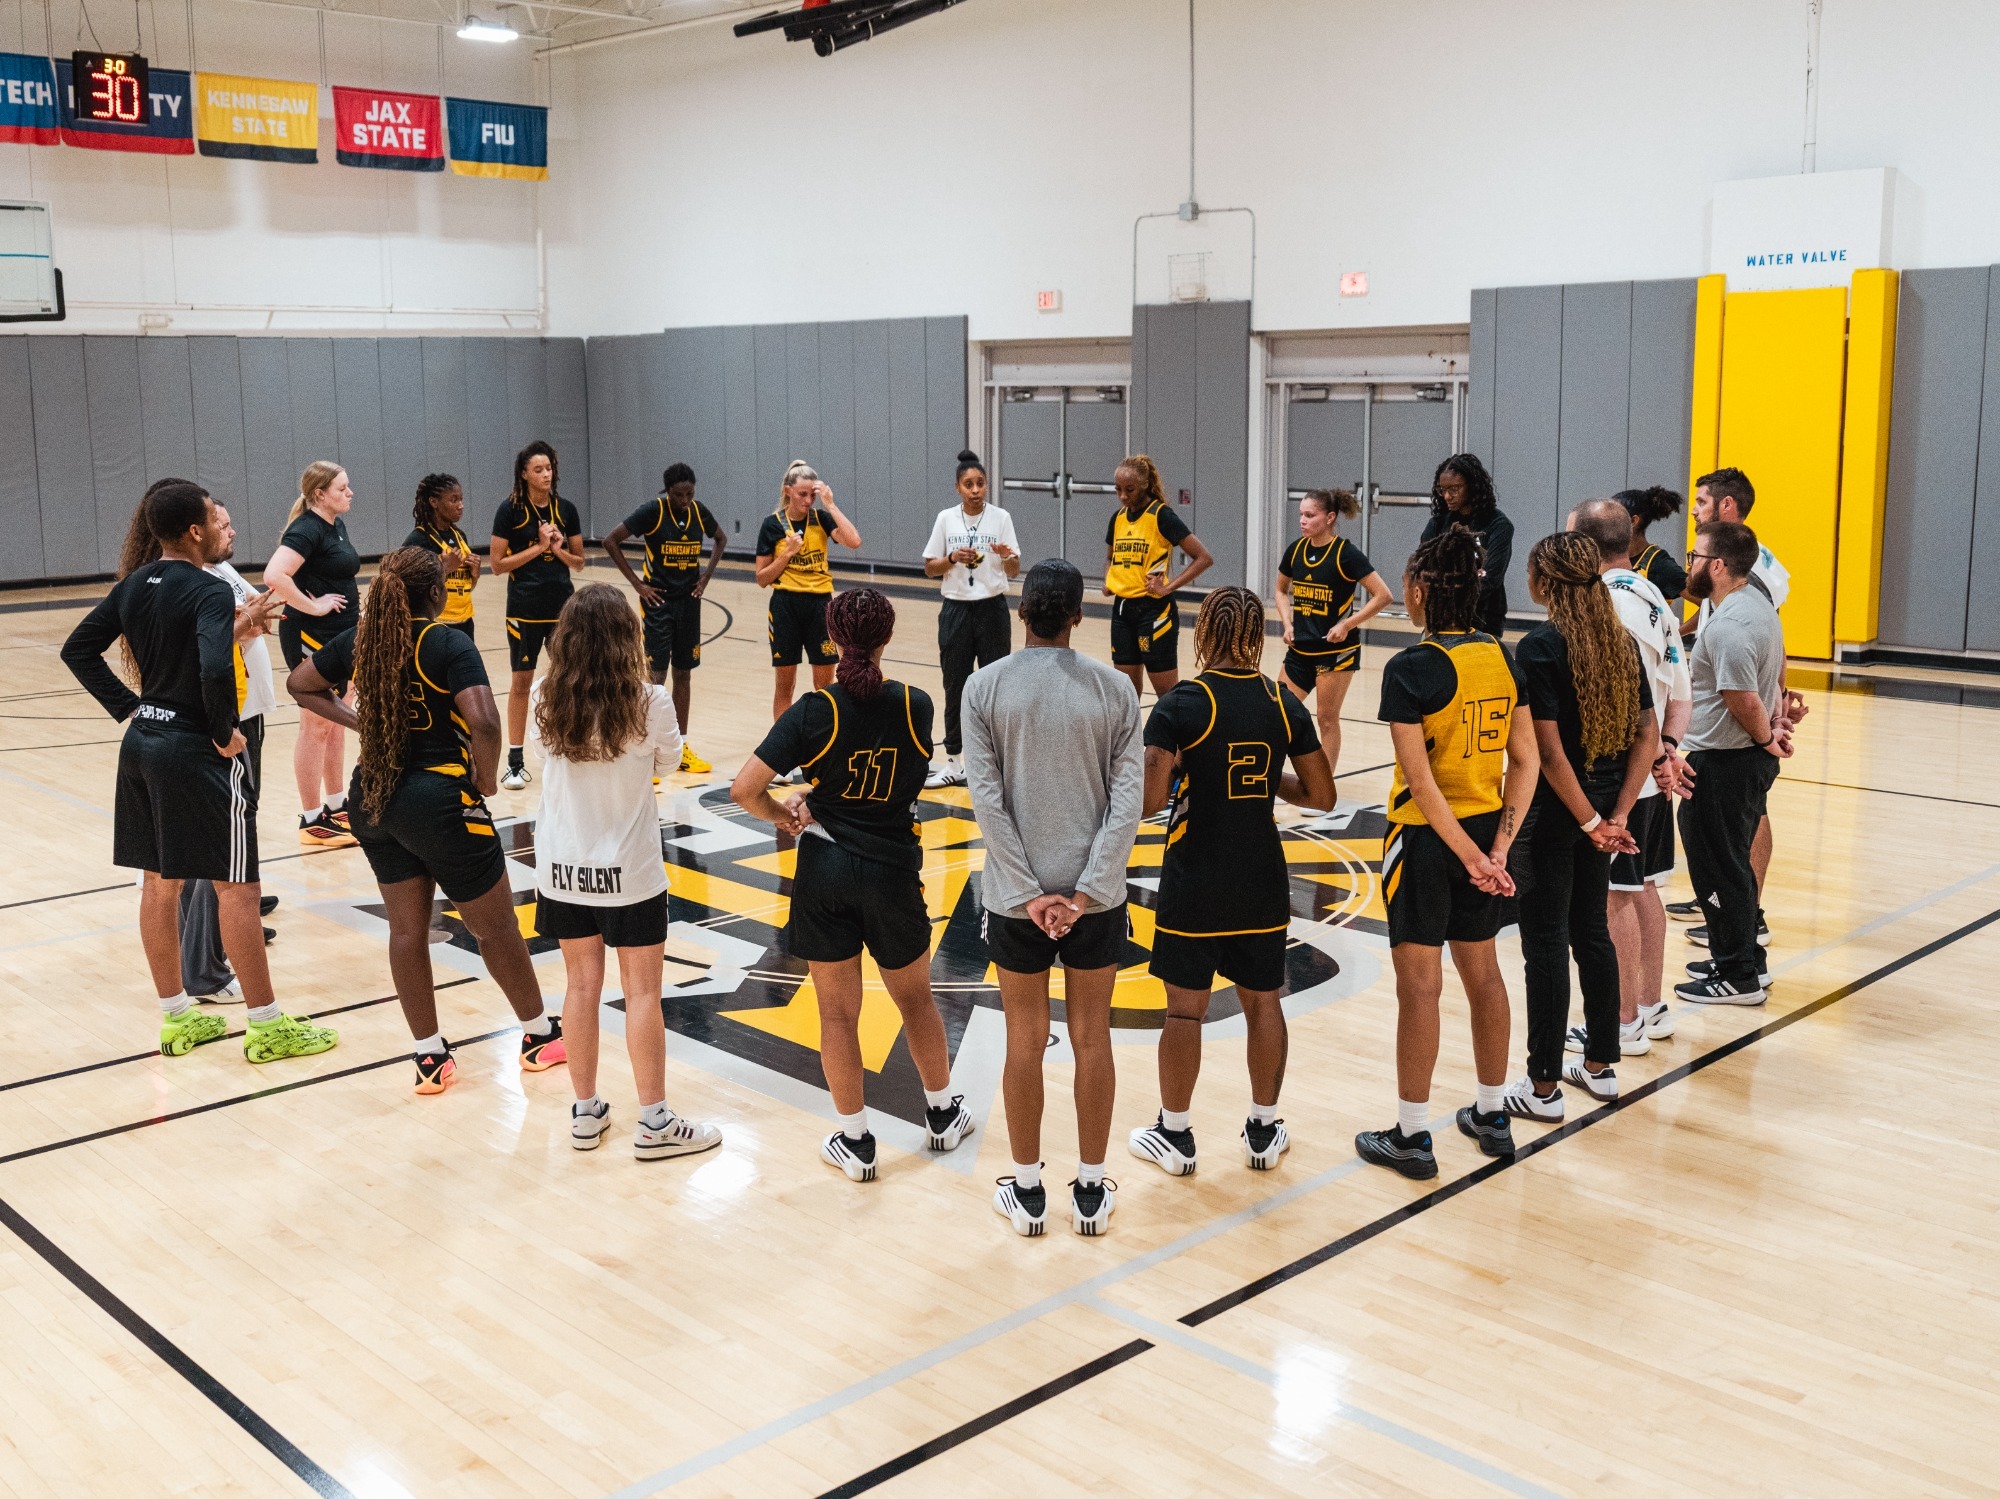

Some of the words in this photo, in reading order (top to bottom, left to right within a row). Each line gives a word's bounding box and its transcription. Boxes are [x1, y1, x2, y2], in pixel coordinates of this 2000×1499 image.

[91, 72, 140, 121] 30
[207, 89, 309, 116] KENNESAW
[365, 99, 412, 125] JAX
[231, 117, 288, 138] STATE
[352, 123, 427, 151] STATE
[481, 122, 515, 146] FIU
[1746, 253, 1794, 267] WATER
[1801, 249, 1848, 263] VALVE
[661, 544, 691, 555] KENNESAW
[1132, 542, 1150, 554] STATE
[1314, 587, 1333, 602] STATE
[1462, 696, 1511, 758] 15
[841, 747, 898, 802] 11
[1227, 741, 1272, 800] 2
[551, 862, 574, 891] FLY
[577, 866, 622, 894] SILENT
